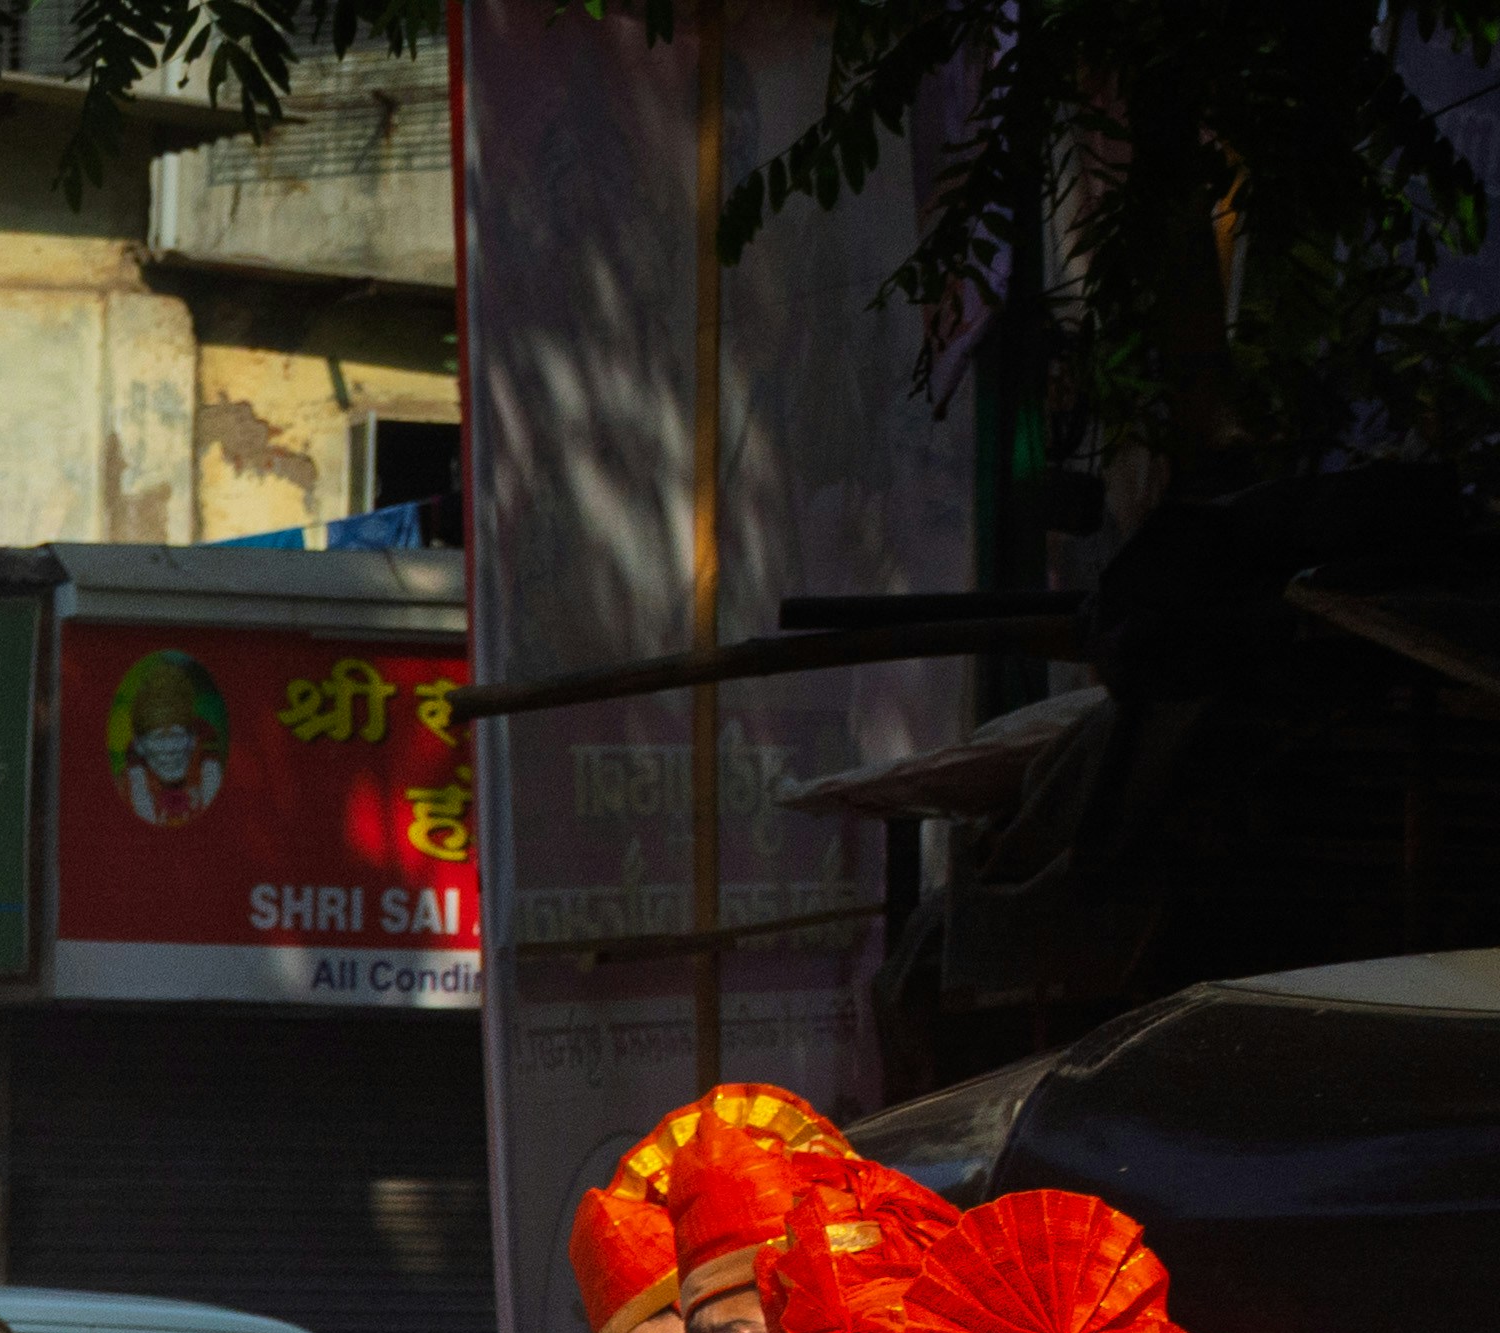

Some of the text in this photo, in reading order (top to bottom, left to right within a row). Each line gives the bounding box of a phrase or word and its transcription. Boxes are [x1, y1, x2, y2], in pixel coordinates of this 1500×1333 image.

[277, 659, 396, 743] श्री
[251, 884, 461, 935] SHRI SAI
[312, 959, 358, 991] All
